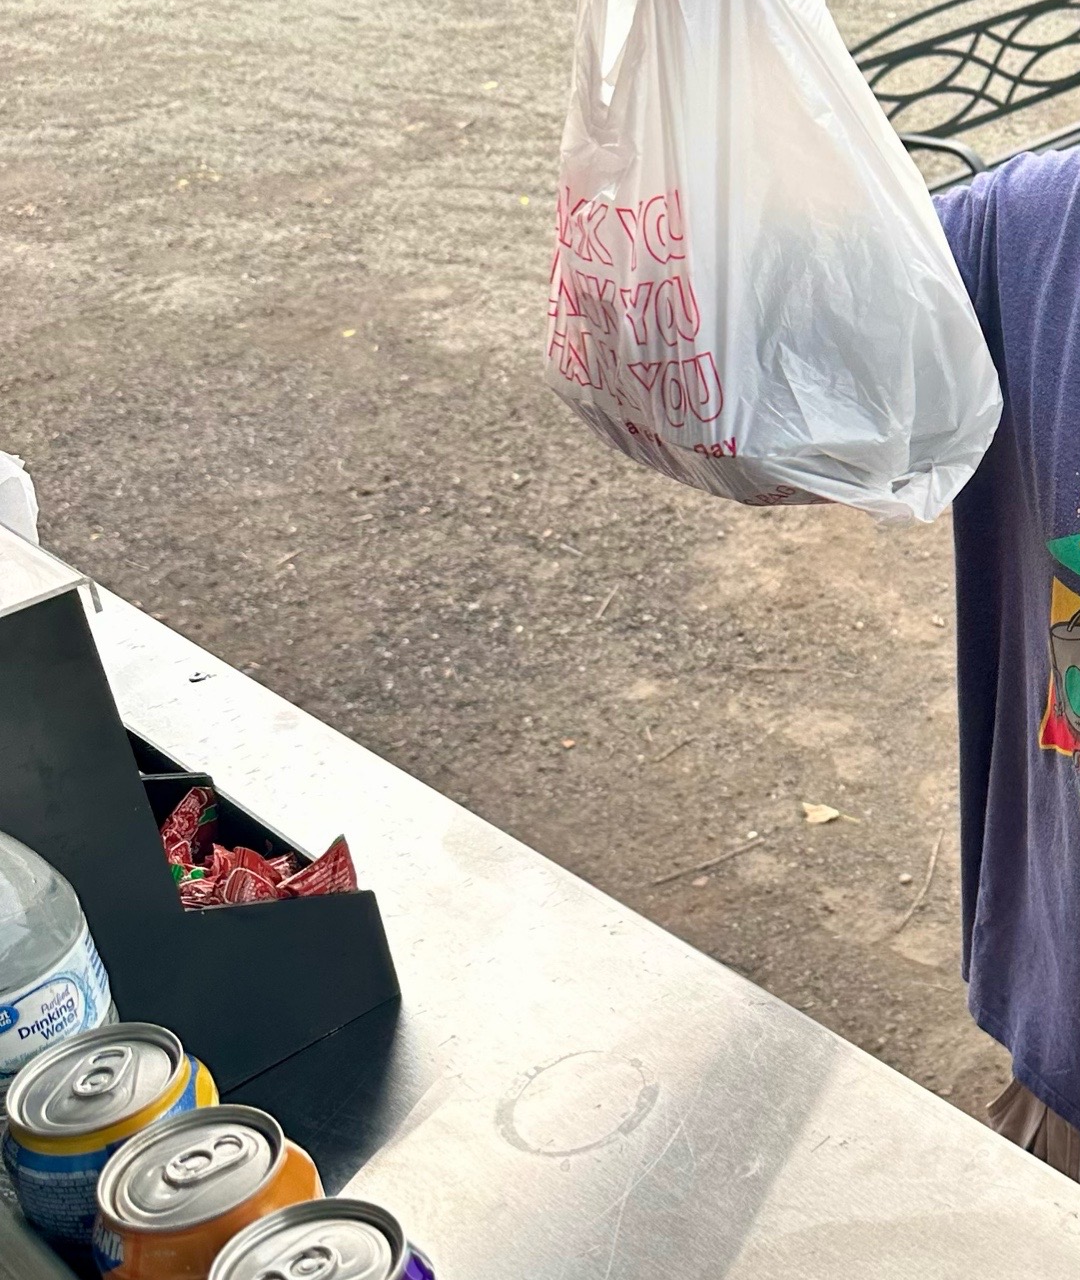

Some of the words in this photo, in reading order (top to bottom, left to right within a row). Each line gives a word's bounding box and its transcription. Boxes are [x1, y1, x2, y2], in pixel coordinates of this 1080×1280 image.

[620, 275, 700, 347] YOU
[627, 351, 724, 428] YOU
[18, 996, 75, 1040] Drinking
[41, 984, 70, 1014] Purified
[41, 1008, 78, 1041] Water
